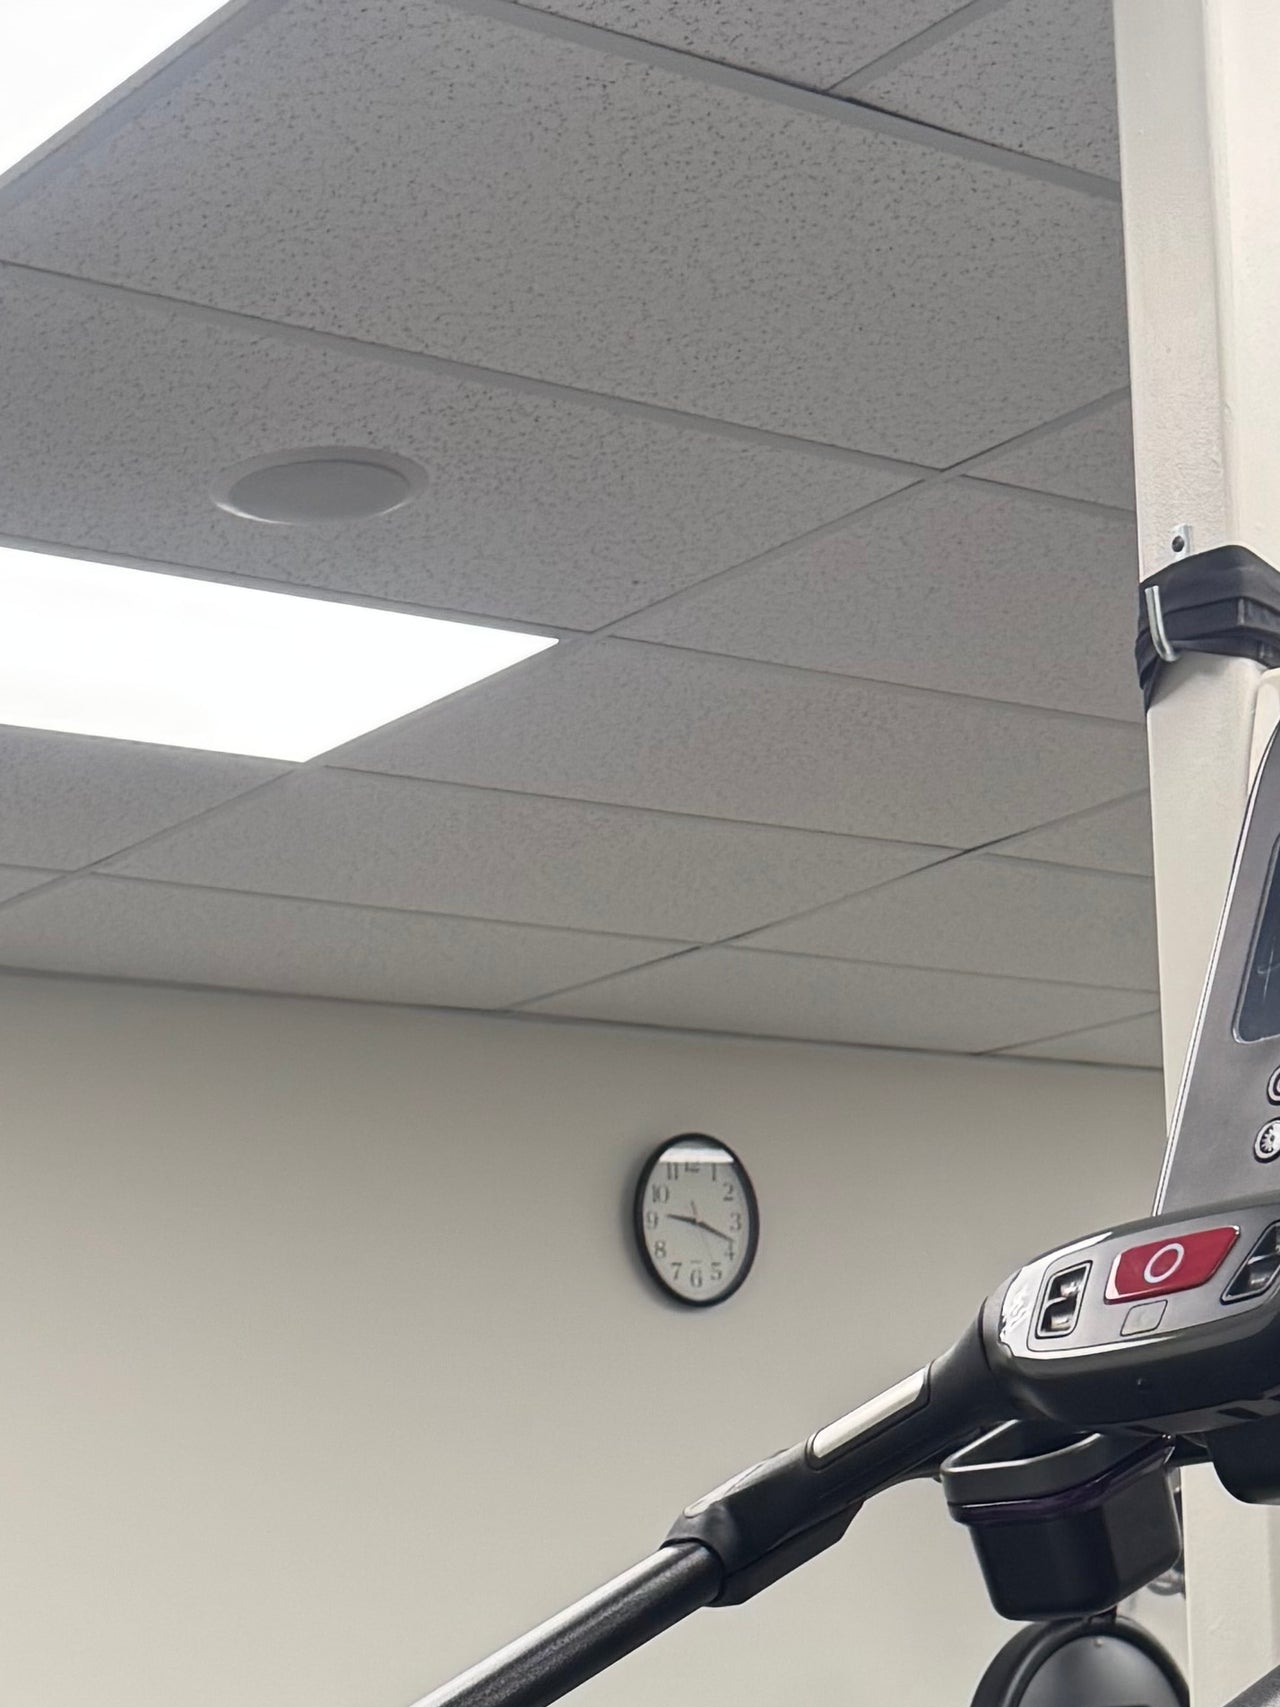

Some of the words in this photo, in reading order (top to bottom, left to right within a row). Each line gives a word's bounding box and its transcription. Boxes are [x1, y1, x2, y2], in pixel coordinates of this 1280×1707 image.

[651, 1183, 670, 1204] 10
[723, 1182, 734, 1202] 2
[645, 1211, 659, 1230] 9
[729, 1213, 742, 1232] 3
[654, 1240, 667, 1259] 8
[670, 1262, 683, 1281] 7
[689, 1269, 704, 1288] 6
[710, 1262, 723, 1281] 5
